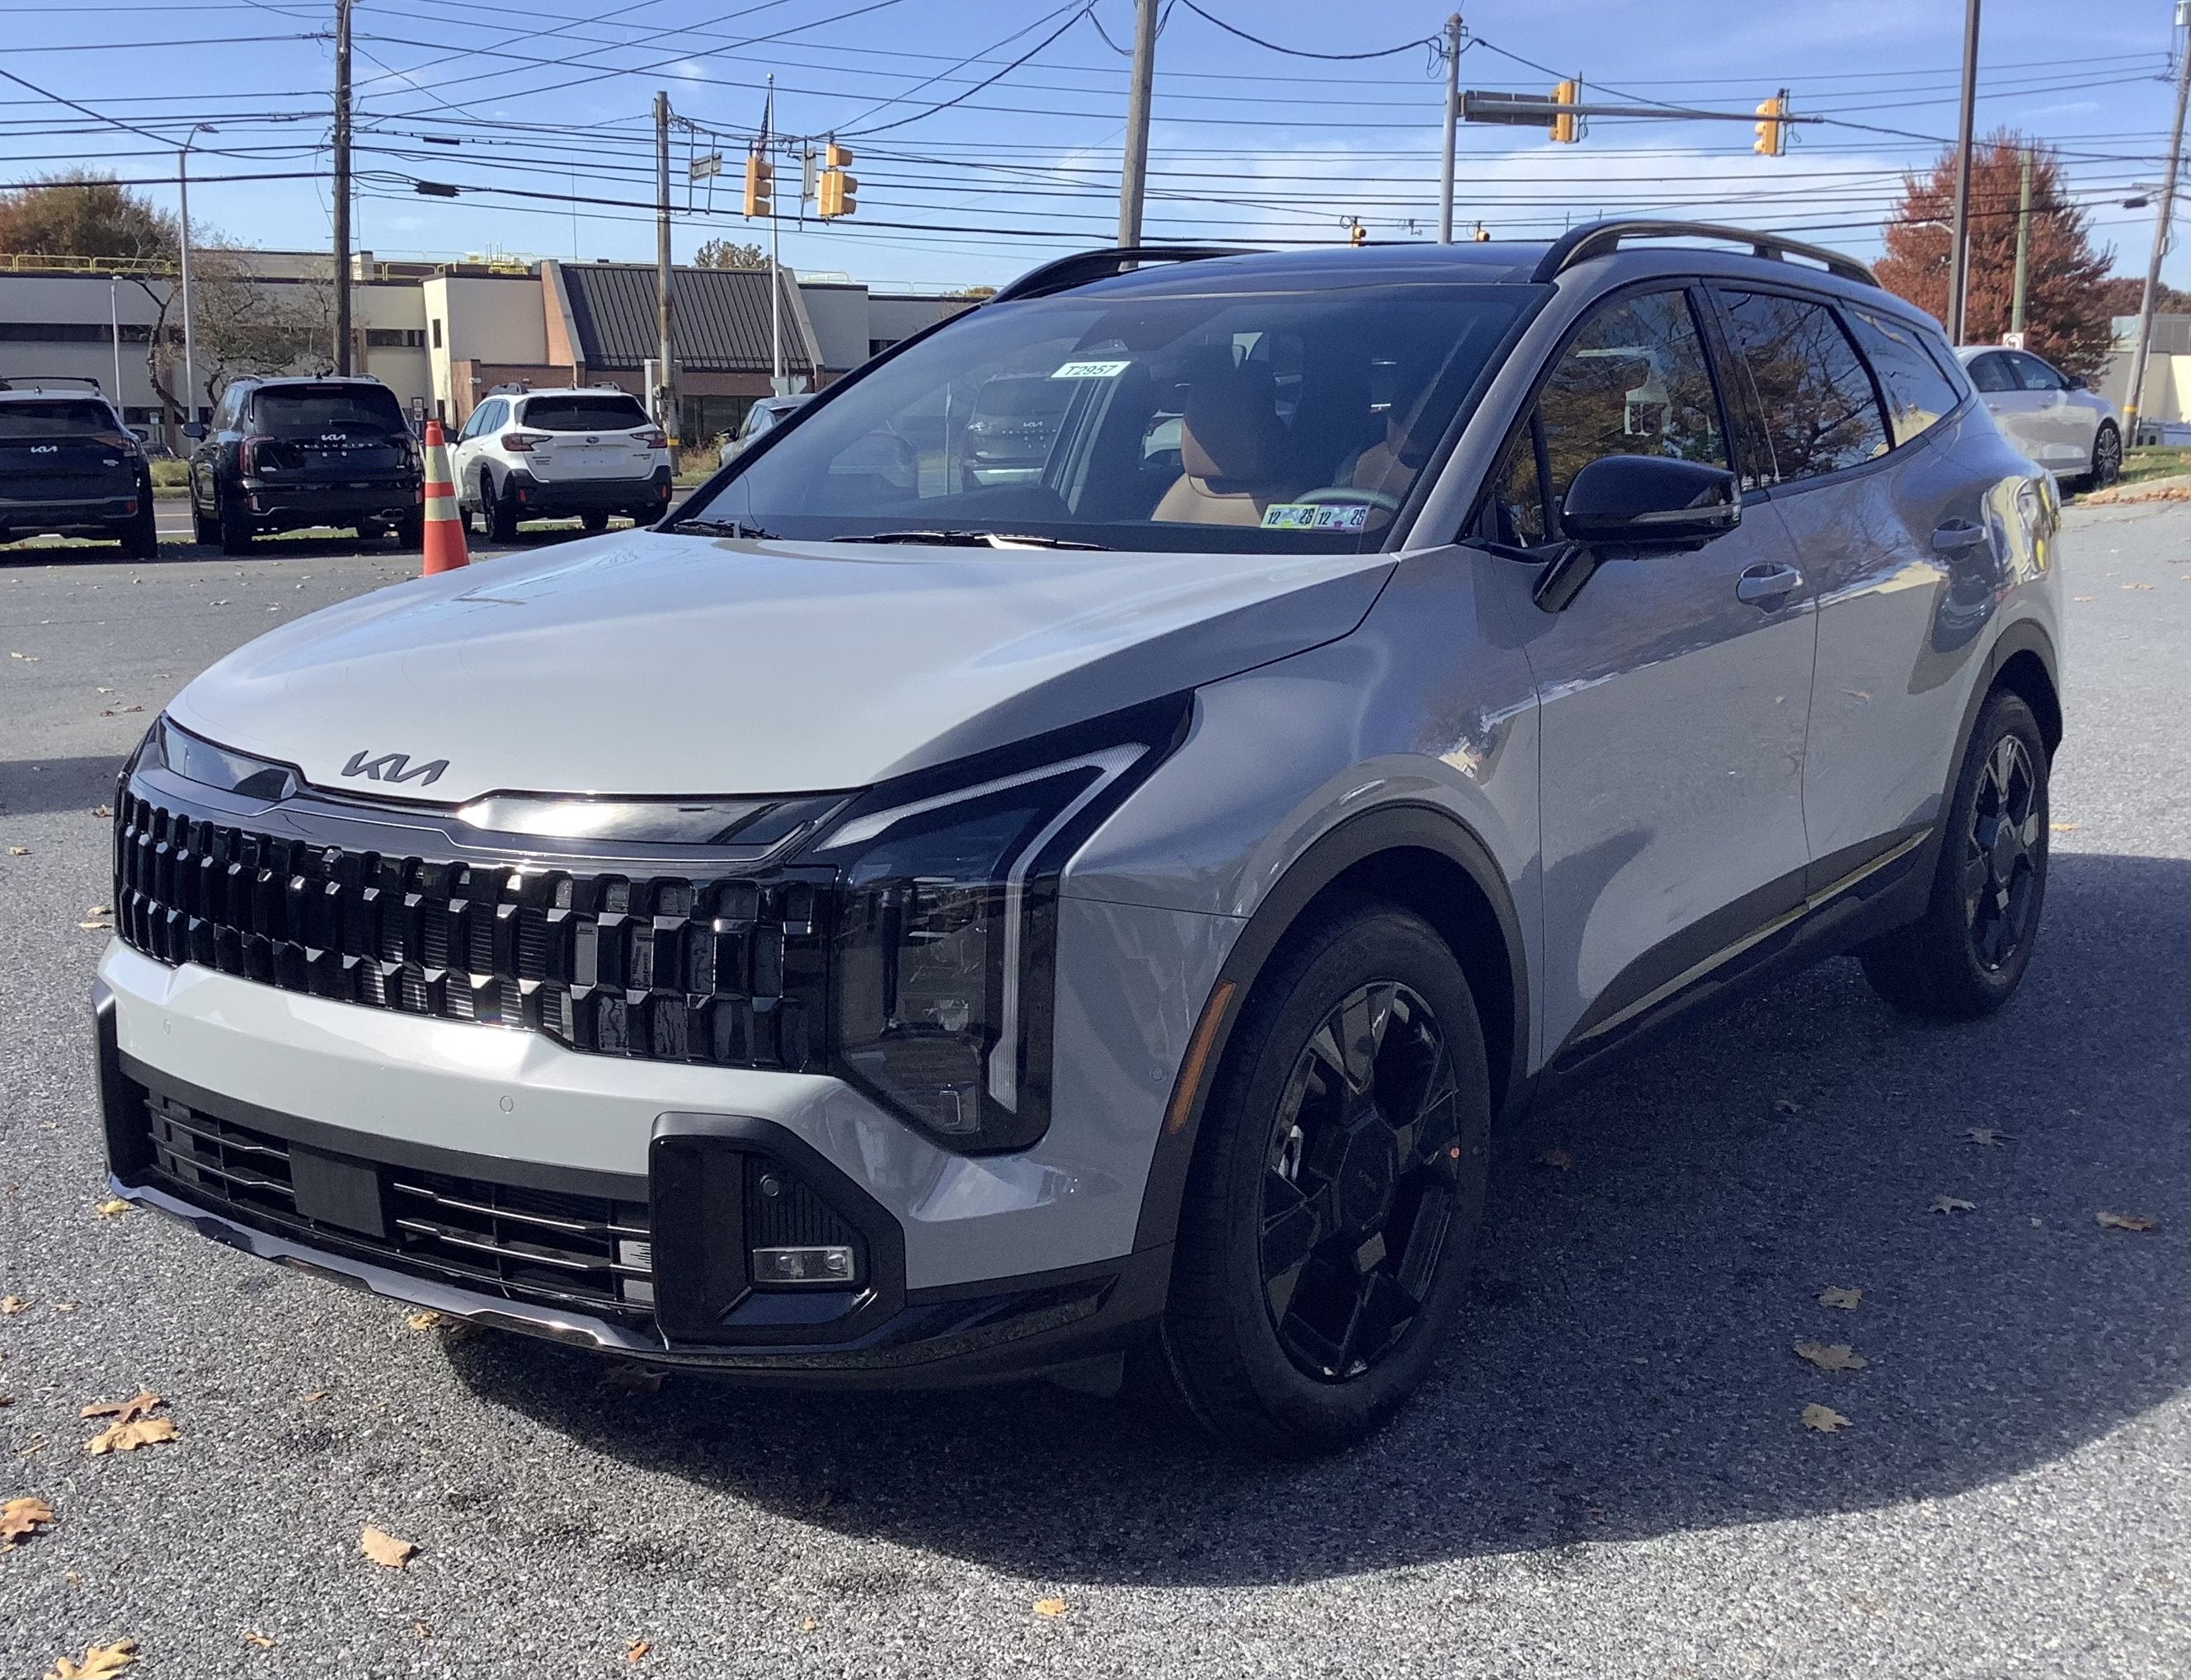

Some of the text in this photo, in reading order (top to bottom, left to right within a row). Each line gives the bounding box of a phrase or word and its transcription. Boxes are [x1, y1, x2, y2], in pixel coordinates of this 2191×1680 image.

[1065, 365, 1118, 375] T2957
[31, 445, 58, 454] KIA
[1267, 511, 1281, 525] 12
[1319, 508, 1366, 526] 12 26
[341, 750, 450, 787] KIA
